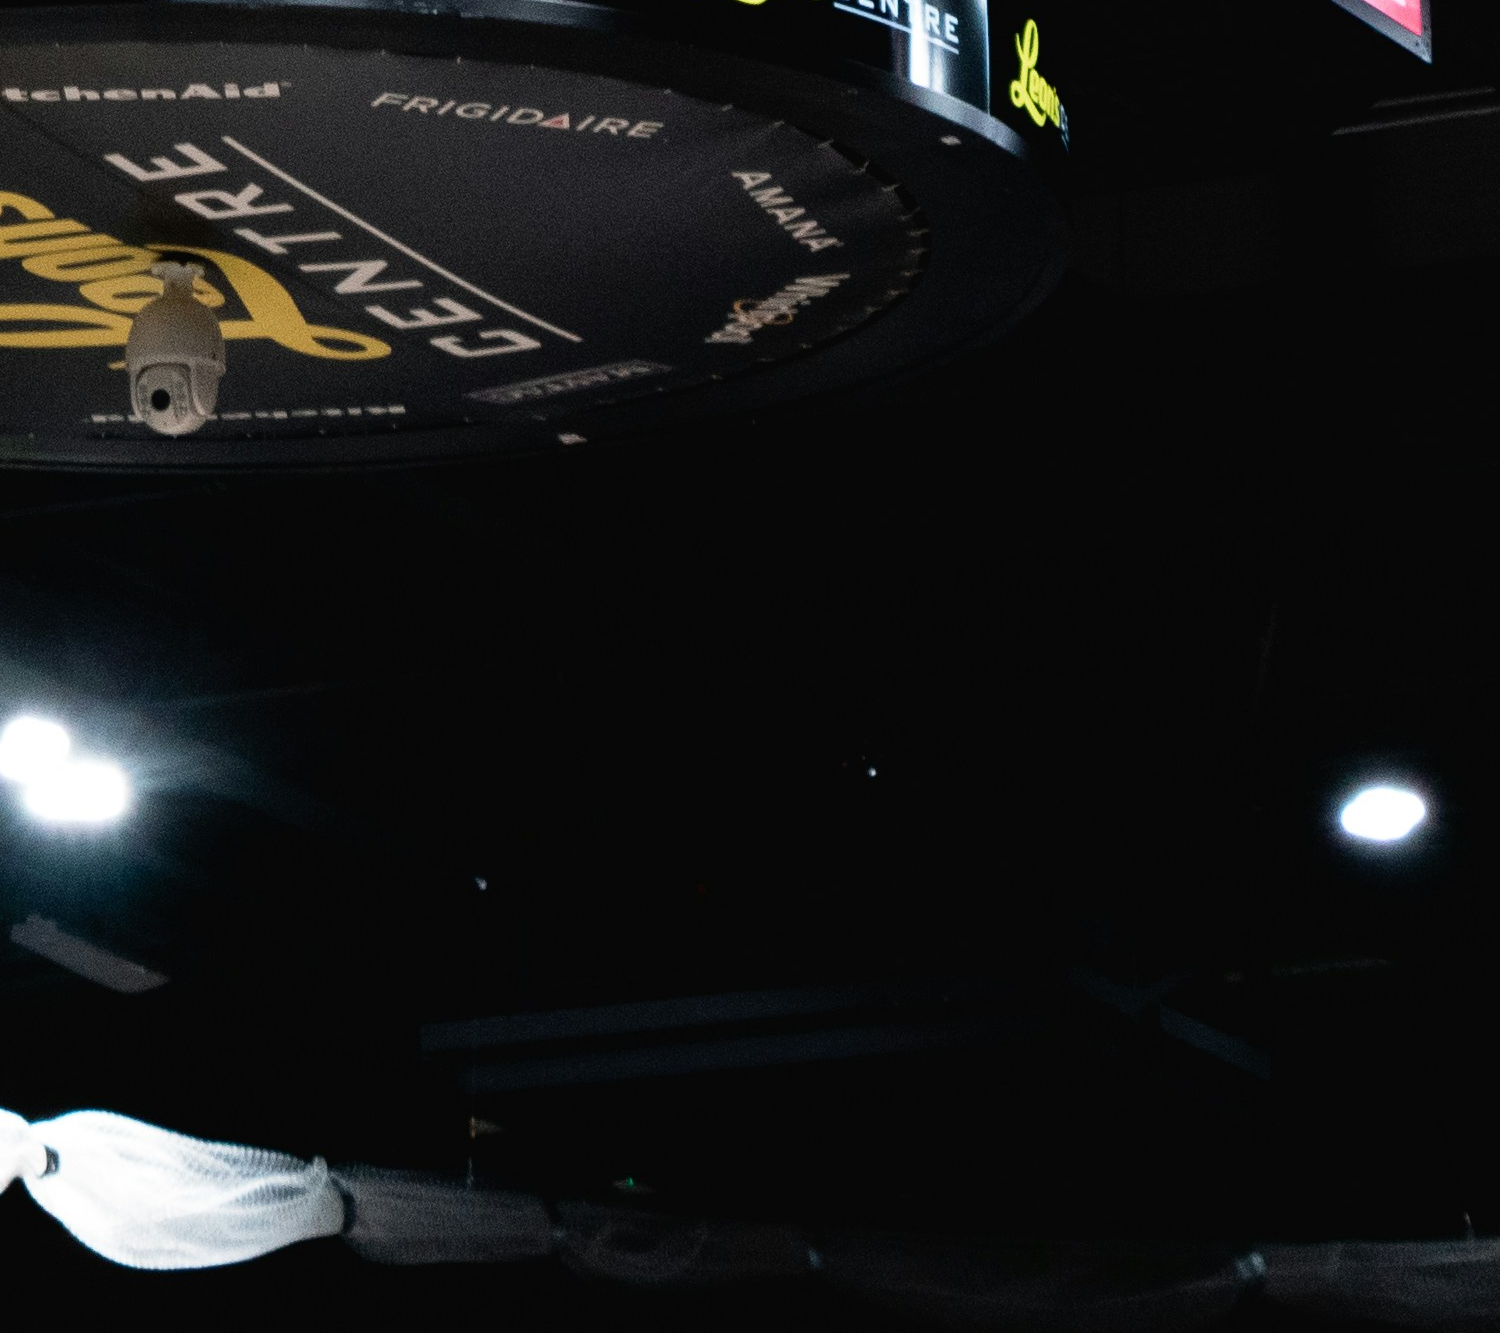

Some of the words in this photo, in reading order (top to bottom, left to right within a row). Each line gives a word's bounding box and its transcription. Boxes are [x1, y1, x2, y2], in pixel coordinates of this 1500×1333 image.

[371, 91, 665, 139] FRIGIDAIRE
[104, 141, 542, 359] CENTRE
[731, 170, 845, 253] AMANA
